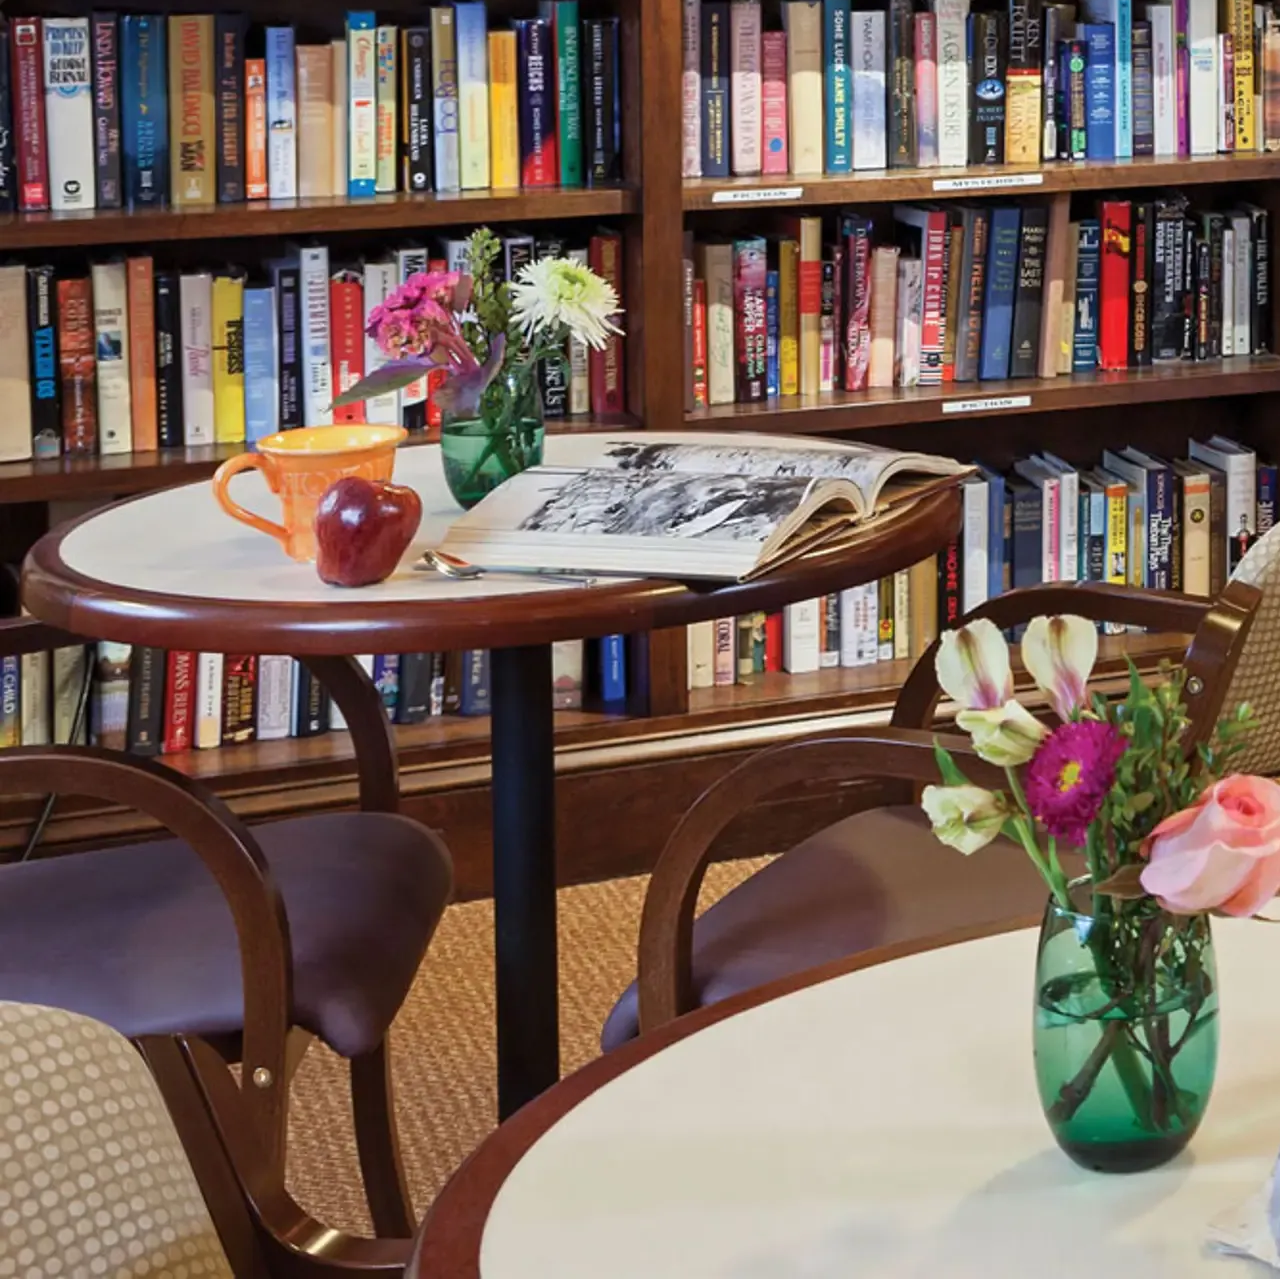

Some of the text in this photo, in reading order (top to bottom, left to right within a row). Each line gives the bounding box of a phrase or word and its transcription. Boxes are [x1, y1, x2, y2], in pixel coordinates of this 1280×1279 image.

[1028, 19, 1039, 47] KEN
[528, 55, 544, 91] REICHS
[834, 10, 845, 146] SOME LUCK JANE SMILEY
[854, 267, 866, 308] BROWN
